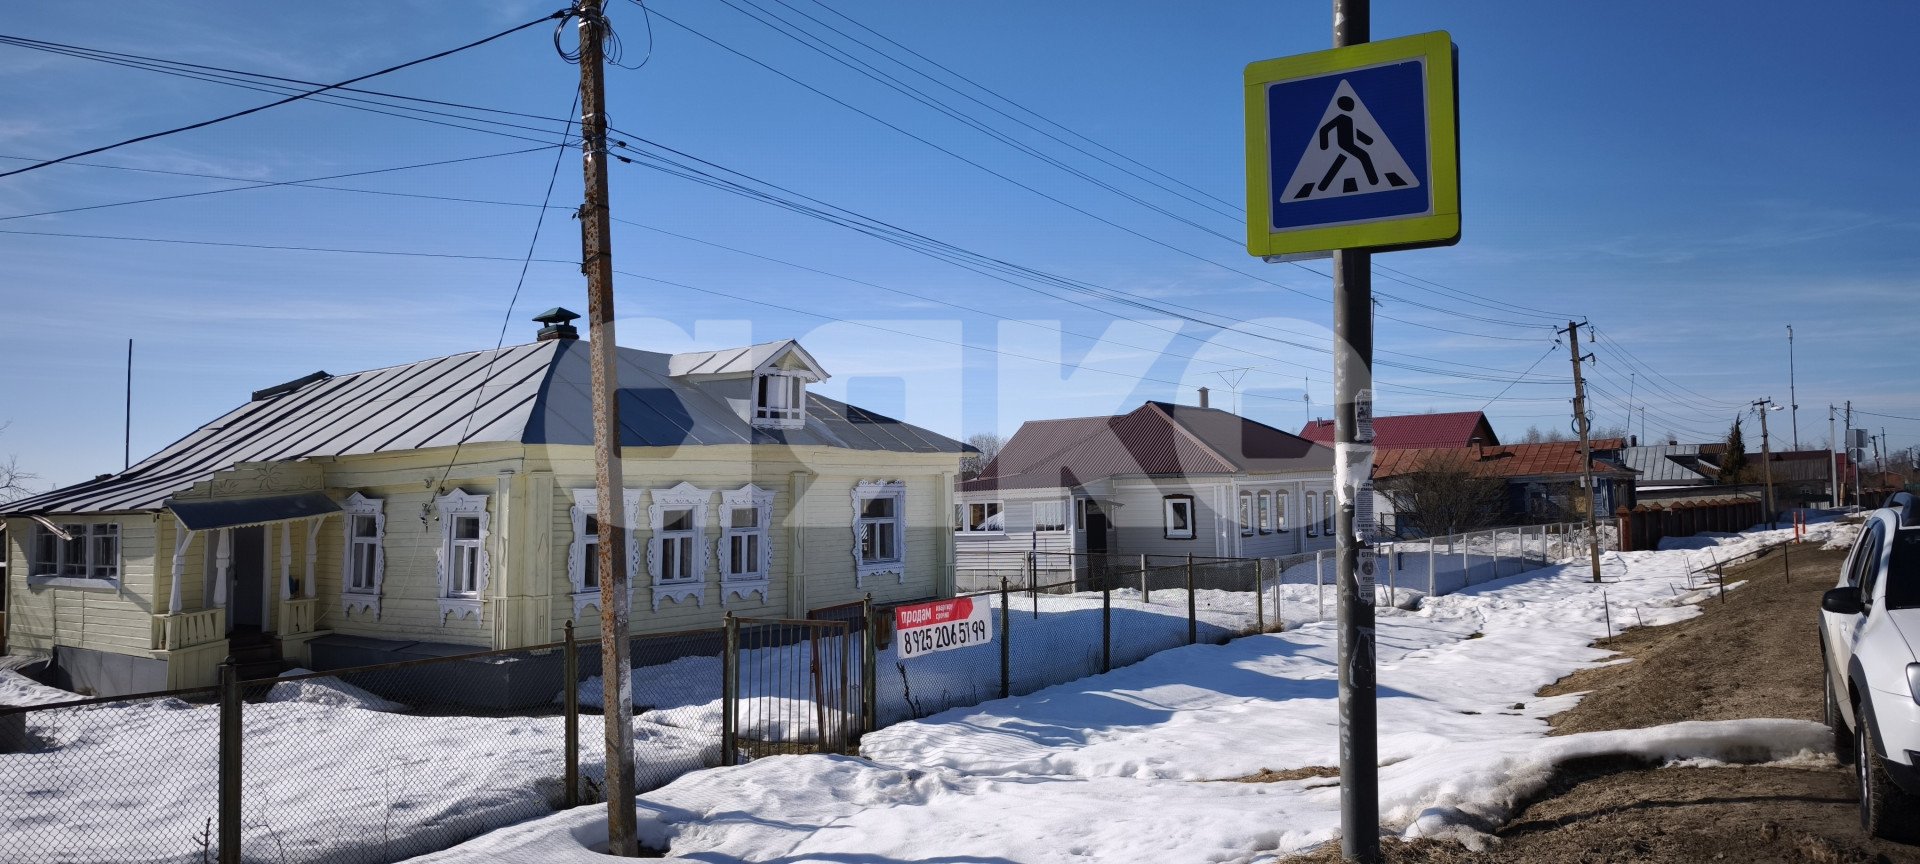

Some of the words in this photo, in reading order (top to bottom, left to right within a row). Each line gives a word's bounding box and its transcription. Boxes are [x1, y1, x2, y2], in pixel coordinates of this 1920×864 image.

[901, 607, 931, 626] продам
[934, 623, 957, 649] 206
[972, 619, 985, 642] 99
